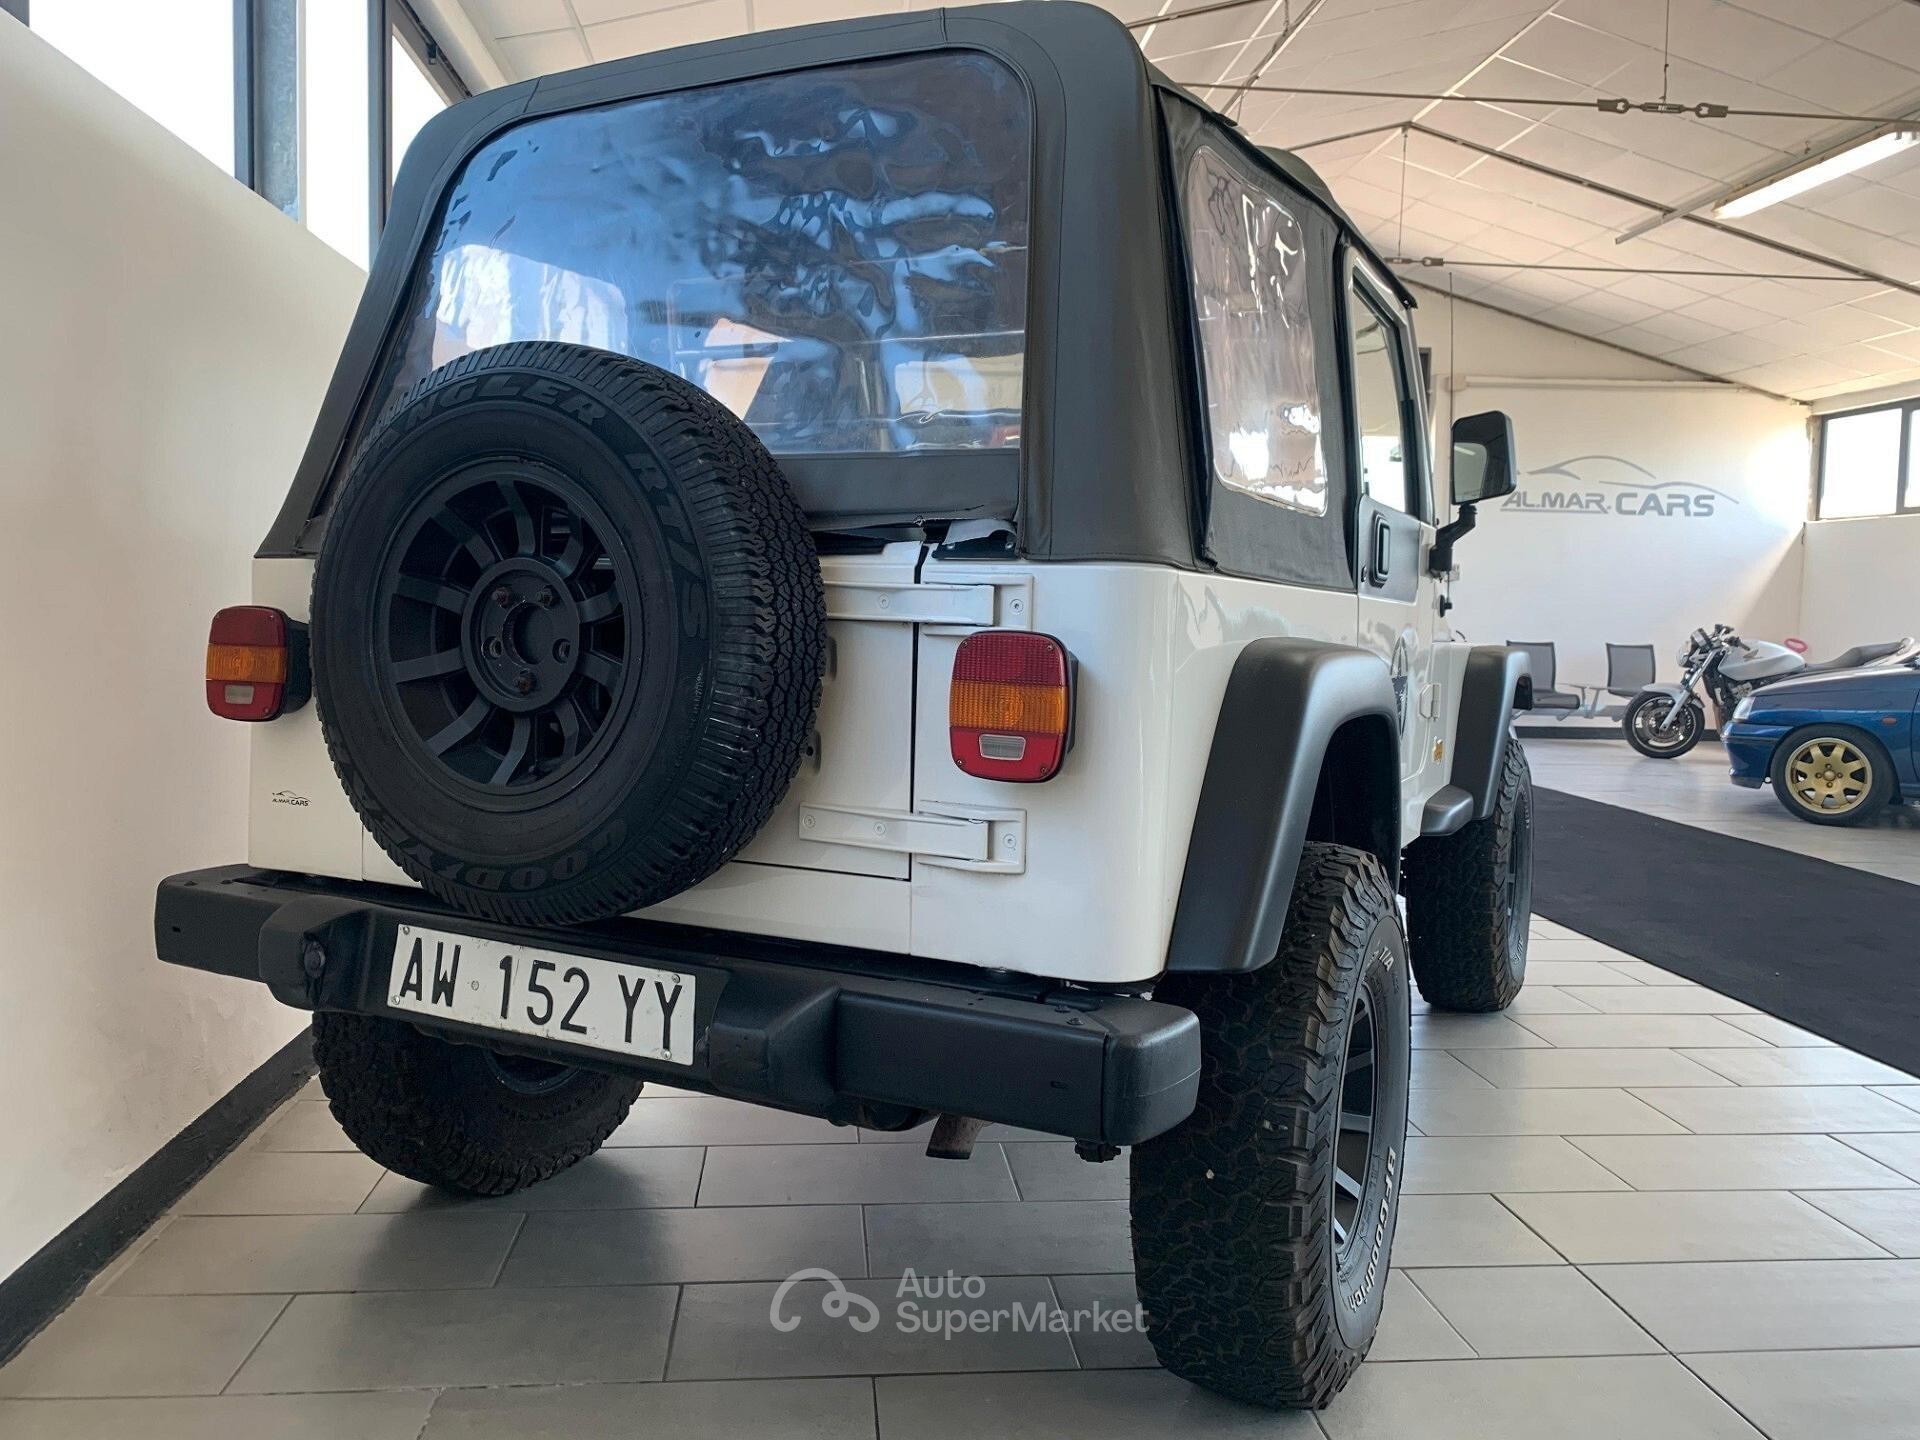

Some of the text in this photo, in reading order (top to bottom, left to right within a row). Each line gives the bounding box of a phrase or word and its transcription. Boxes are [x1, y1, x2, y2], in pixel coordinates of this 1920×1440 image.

[1615, 492, 1715, 516] CARS
[399, 937, 683, 1050] AW 152 YY
